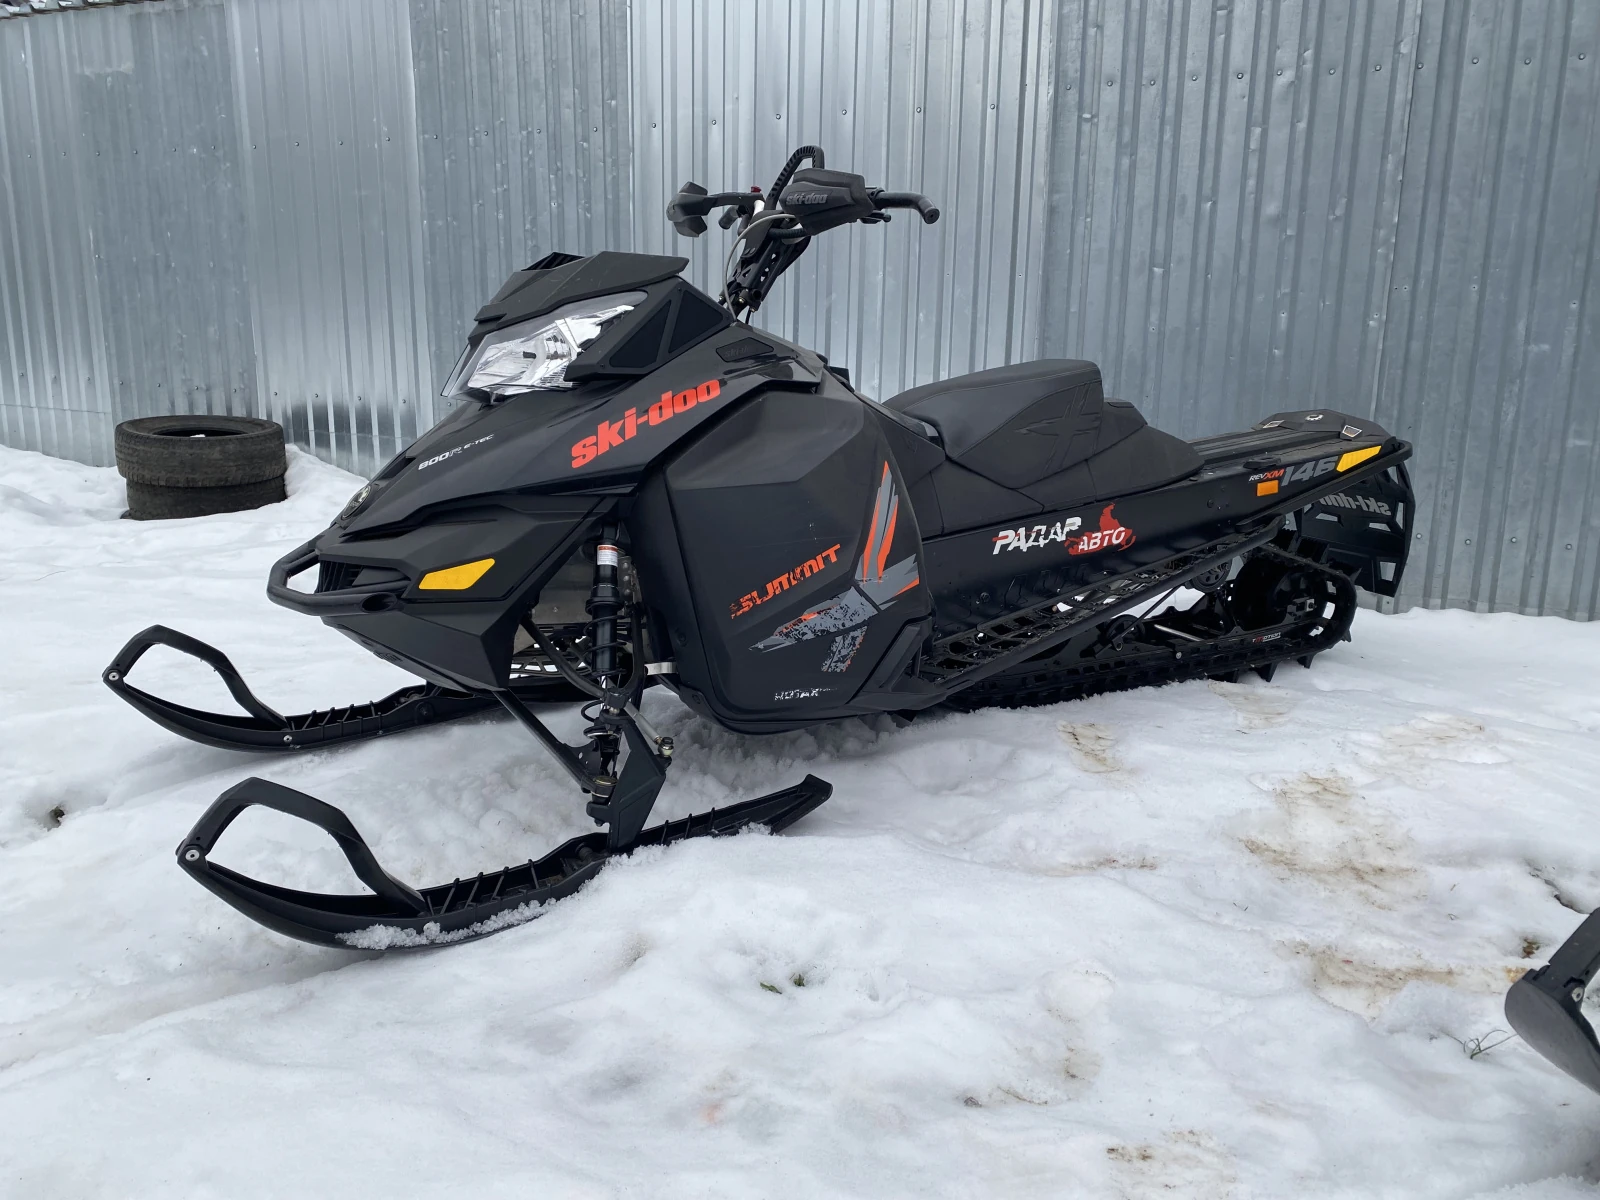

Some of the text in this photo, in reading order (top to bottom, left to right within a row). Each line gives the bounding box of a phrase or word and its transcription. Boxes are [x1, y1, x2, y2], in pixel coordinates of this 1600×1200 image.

[786, 192, 828, 205] ski-doo
[571, 379, 721, 469] ski-doo
[1281, 455, 1338, 486] 146
[992, 516, 1126, 555] РАДАР АВТО
[729, 543, 841, 619] SUMMIT
